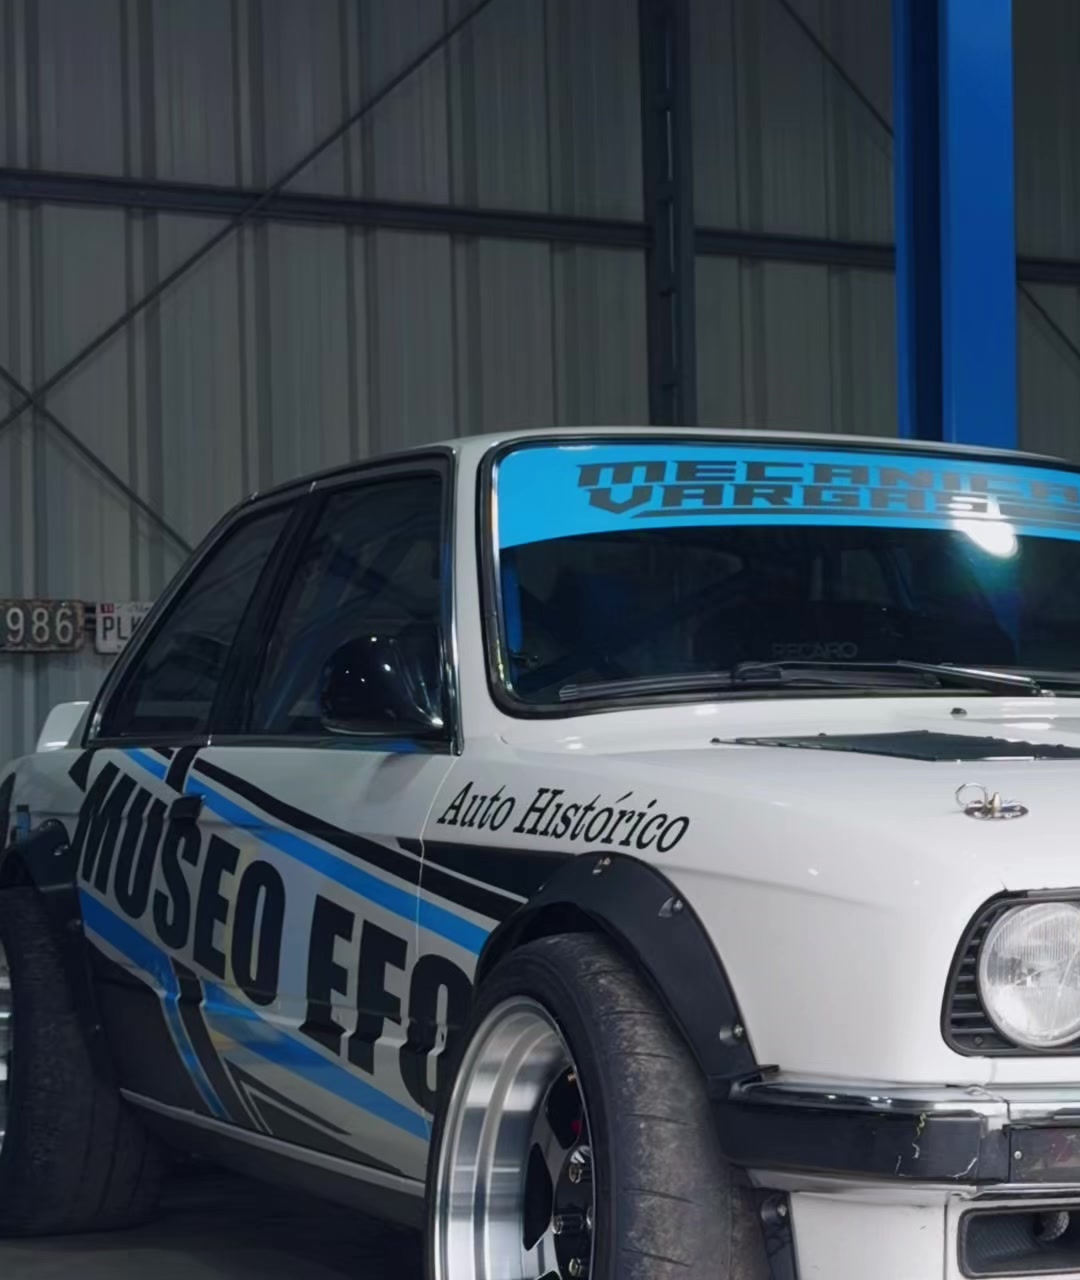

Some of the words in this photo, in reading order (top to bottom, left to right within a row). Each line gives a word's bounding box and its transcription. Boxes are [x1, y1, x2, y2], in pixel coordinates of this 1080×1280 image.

[584, 483, 990, 515] VARGAS
[6, 607, 74, 644] 986
[436, 780, 517, 832] Auto
[76, 760, 287, 1007] MUSEO
